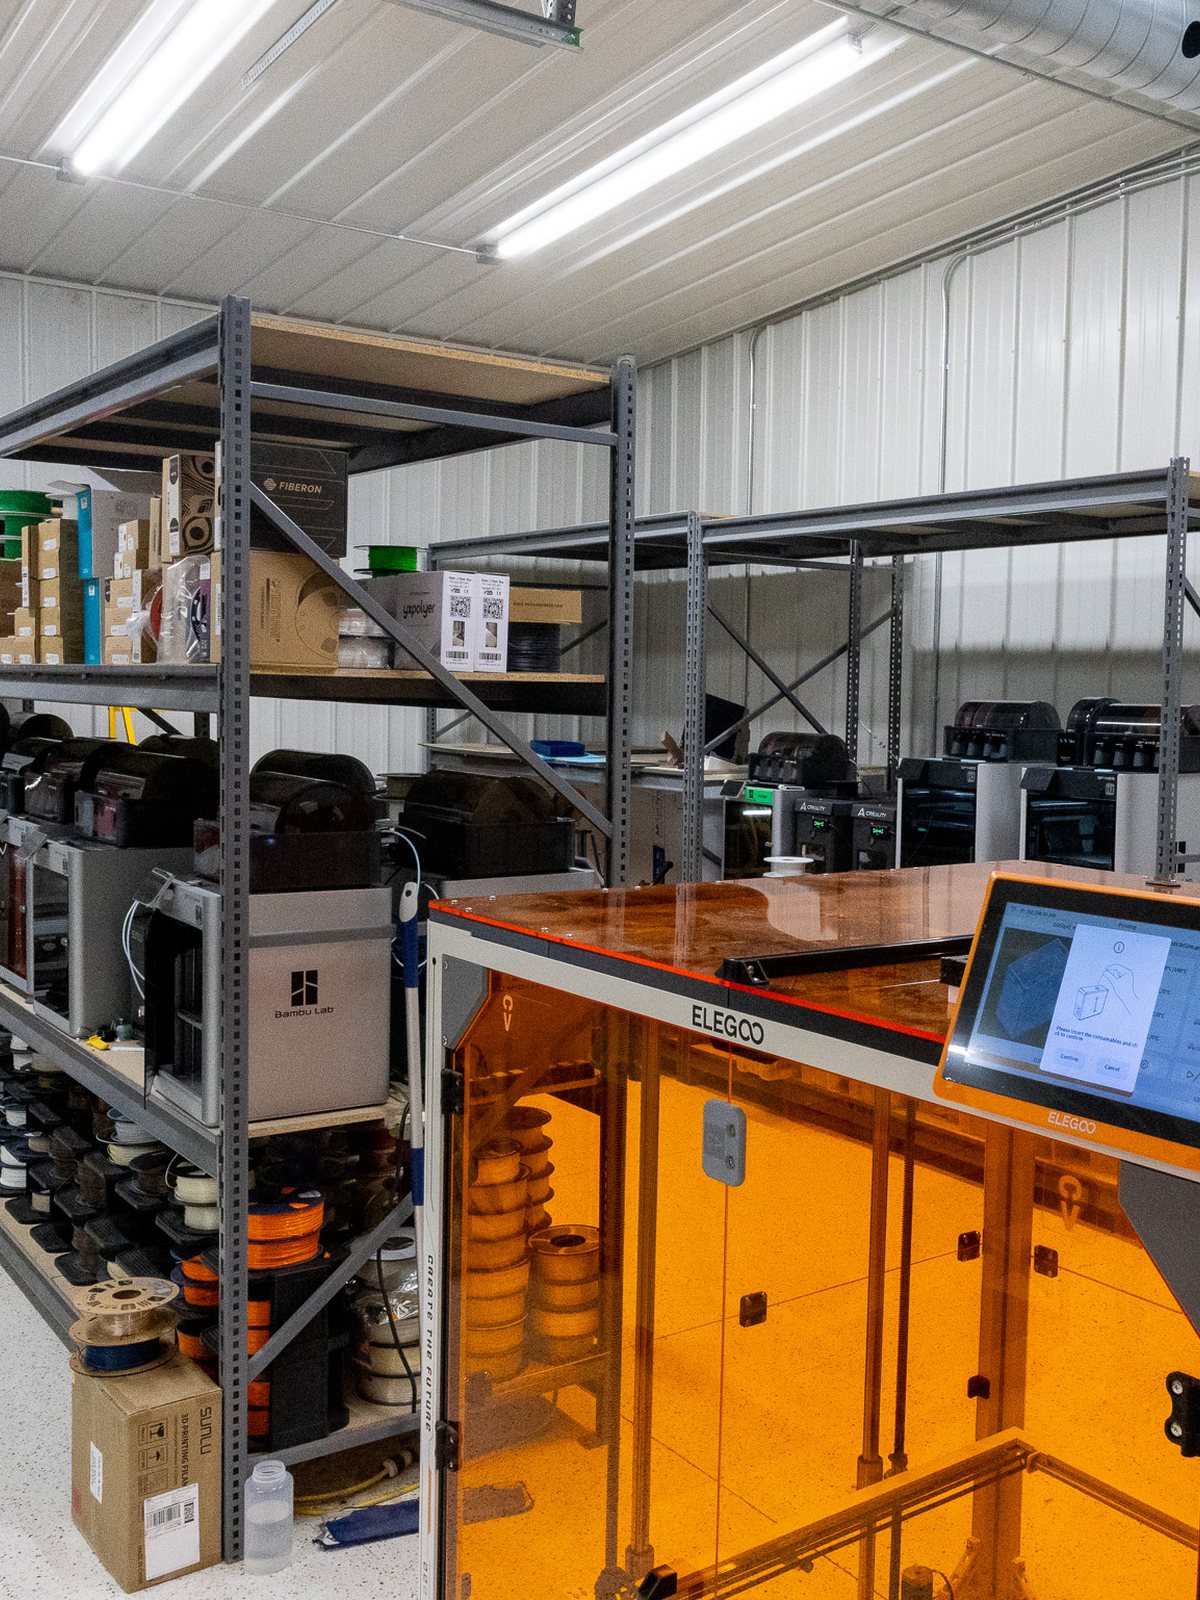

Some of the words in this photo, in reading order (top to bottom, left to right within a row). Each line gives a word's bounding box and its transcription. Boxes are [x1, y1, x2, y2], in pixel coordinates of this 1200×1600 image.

[278, 481, 322, 494] FIBERON
[865, 810, 887, 818] CREALITY
[274, 1008, 312, 1019] Bambu
[314, 1005, 334, 1015] Lab
[691, 1004, 764, 1045] ELEGOO
[1056, 1025, 1072, 1034] Please
[1084, 1030, 1092, 1038] the
[1066, 1033, 1084, 1041] confirm
[1060, 1053, 1079, 1062] Confirm
[1104, 1063, 1120, 1072] Cancel
[1047, 1111, 1097, 1135] ELEGOO
[426, 1254, 435, 1321] CREATE
[424, 1366, 433, 1433] FUTURE
[181, 1413, 189, 1423] 3D
[181, 1424, 189, 1468] PRINTING
